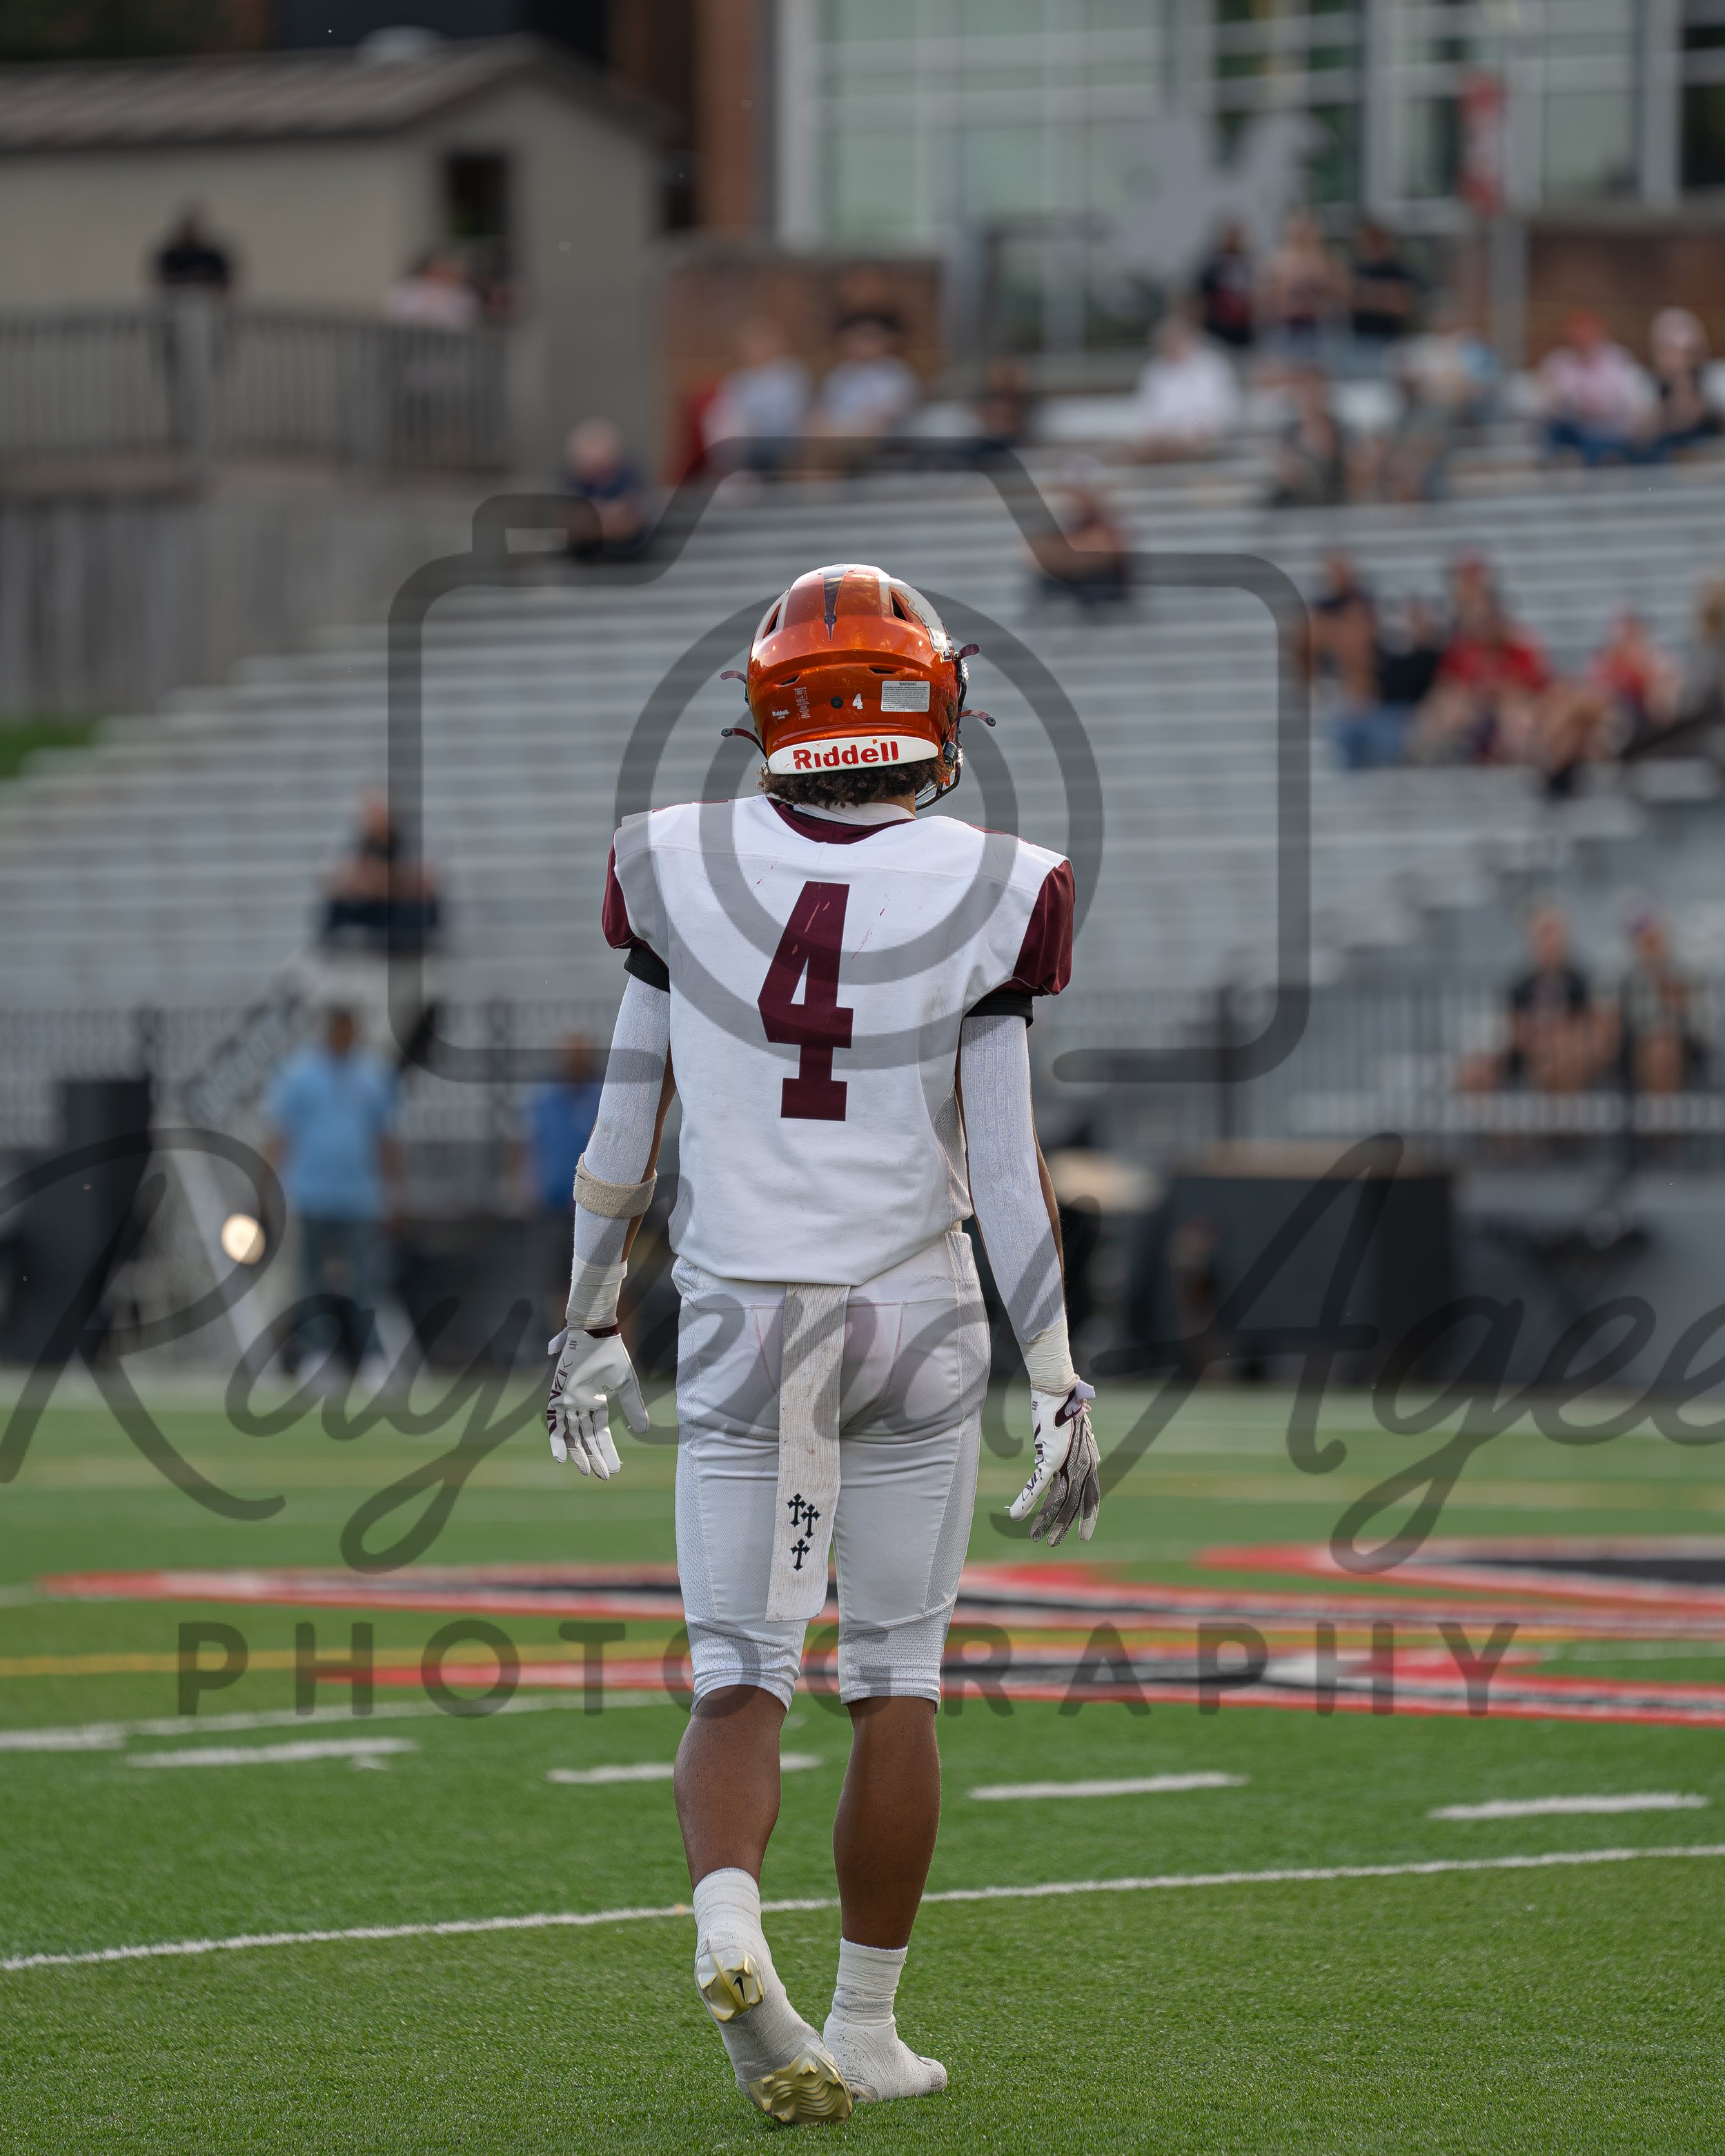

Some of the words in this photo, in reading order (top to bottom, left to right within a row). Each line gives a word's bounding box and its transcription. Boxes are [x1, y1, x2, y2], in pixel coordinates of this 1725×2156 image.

[852, 693, 863, 710] 4
[793, 740, 899, 770] Riddell
[757, 880, 854, 1122] 4
